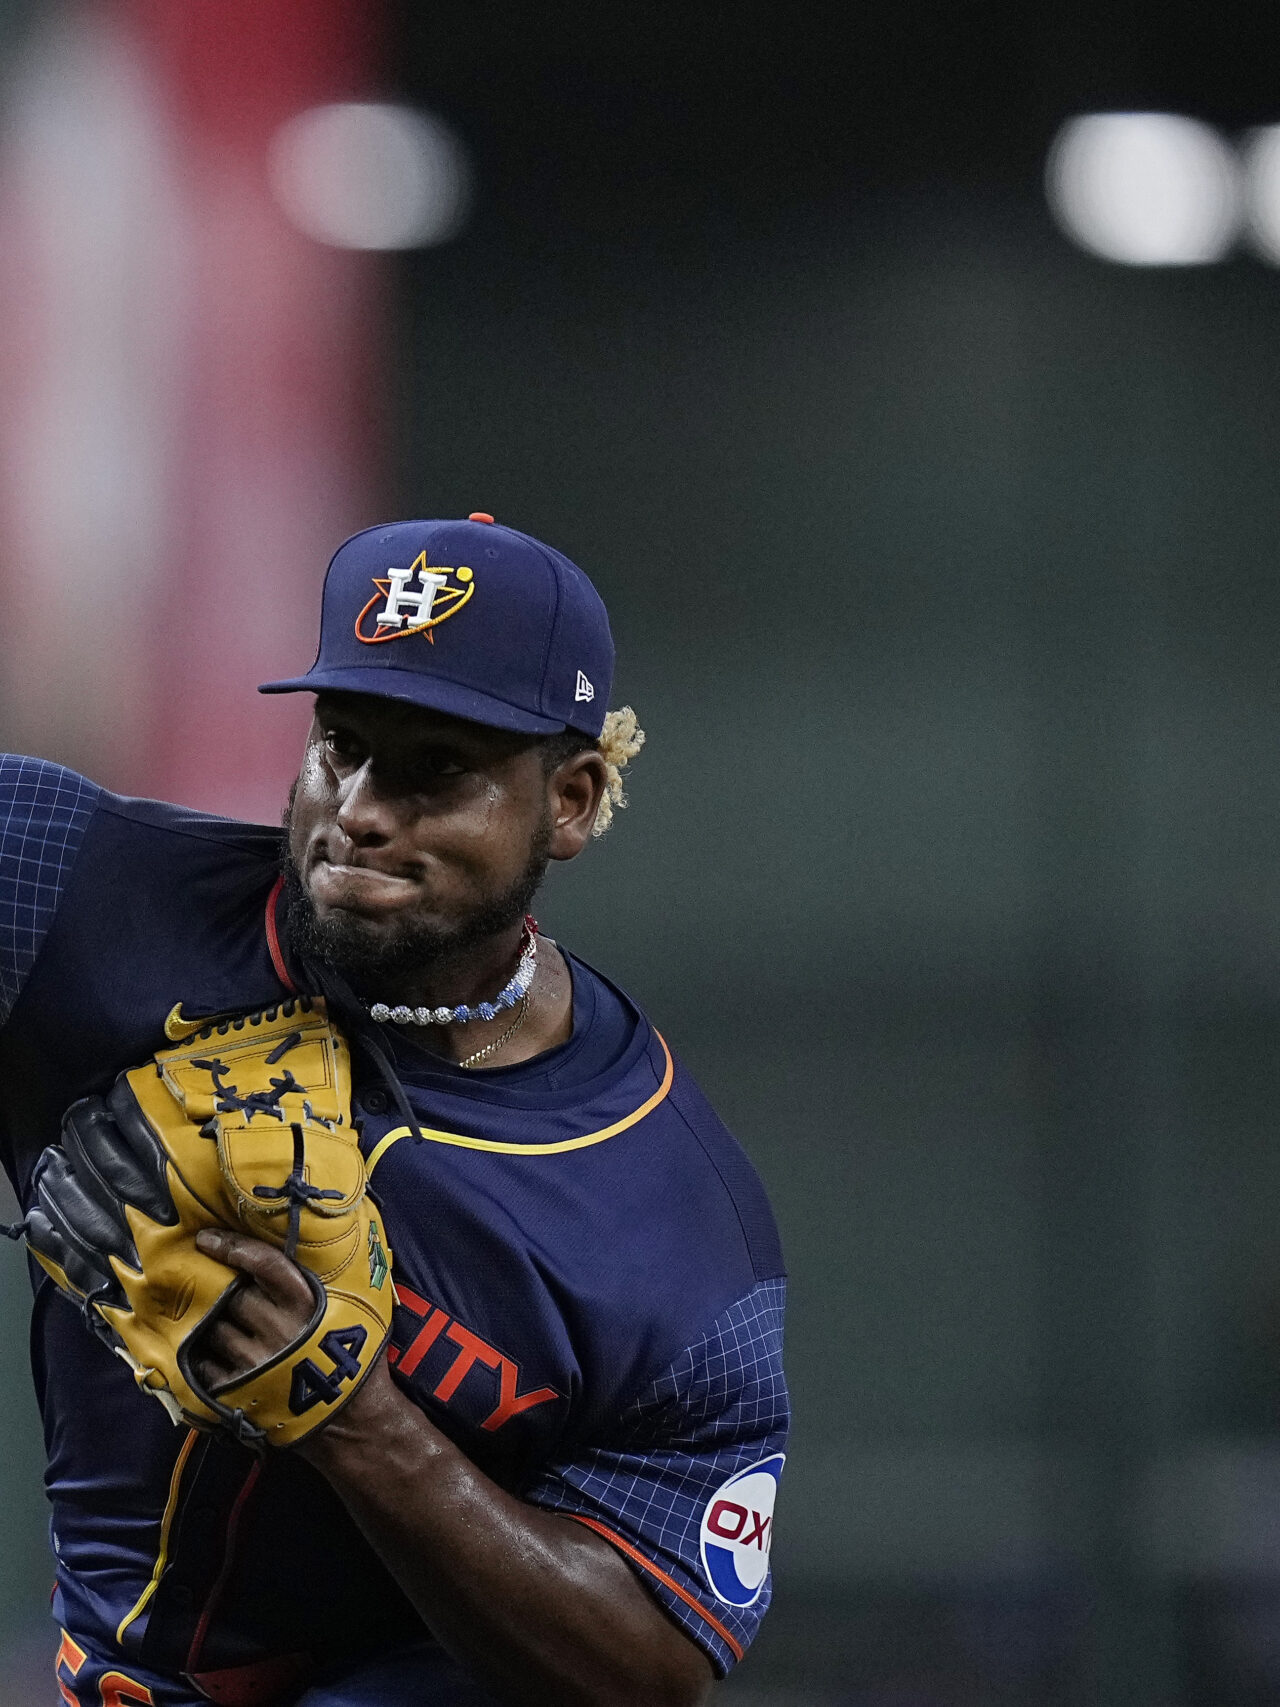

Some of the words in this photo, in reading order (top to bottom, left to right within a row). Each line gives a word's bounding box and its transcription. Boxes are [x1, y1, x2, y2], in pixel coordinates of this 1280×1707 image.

[376, 568, 447, 628] H
[288, 1323, 368, 1416] 44
[707, 1500, 772, 1554] OX
